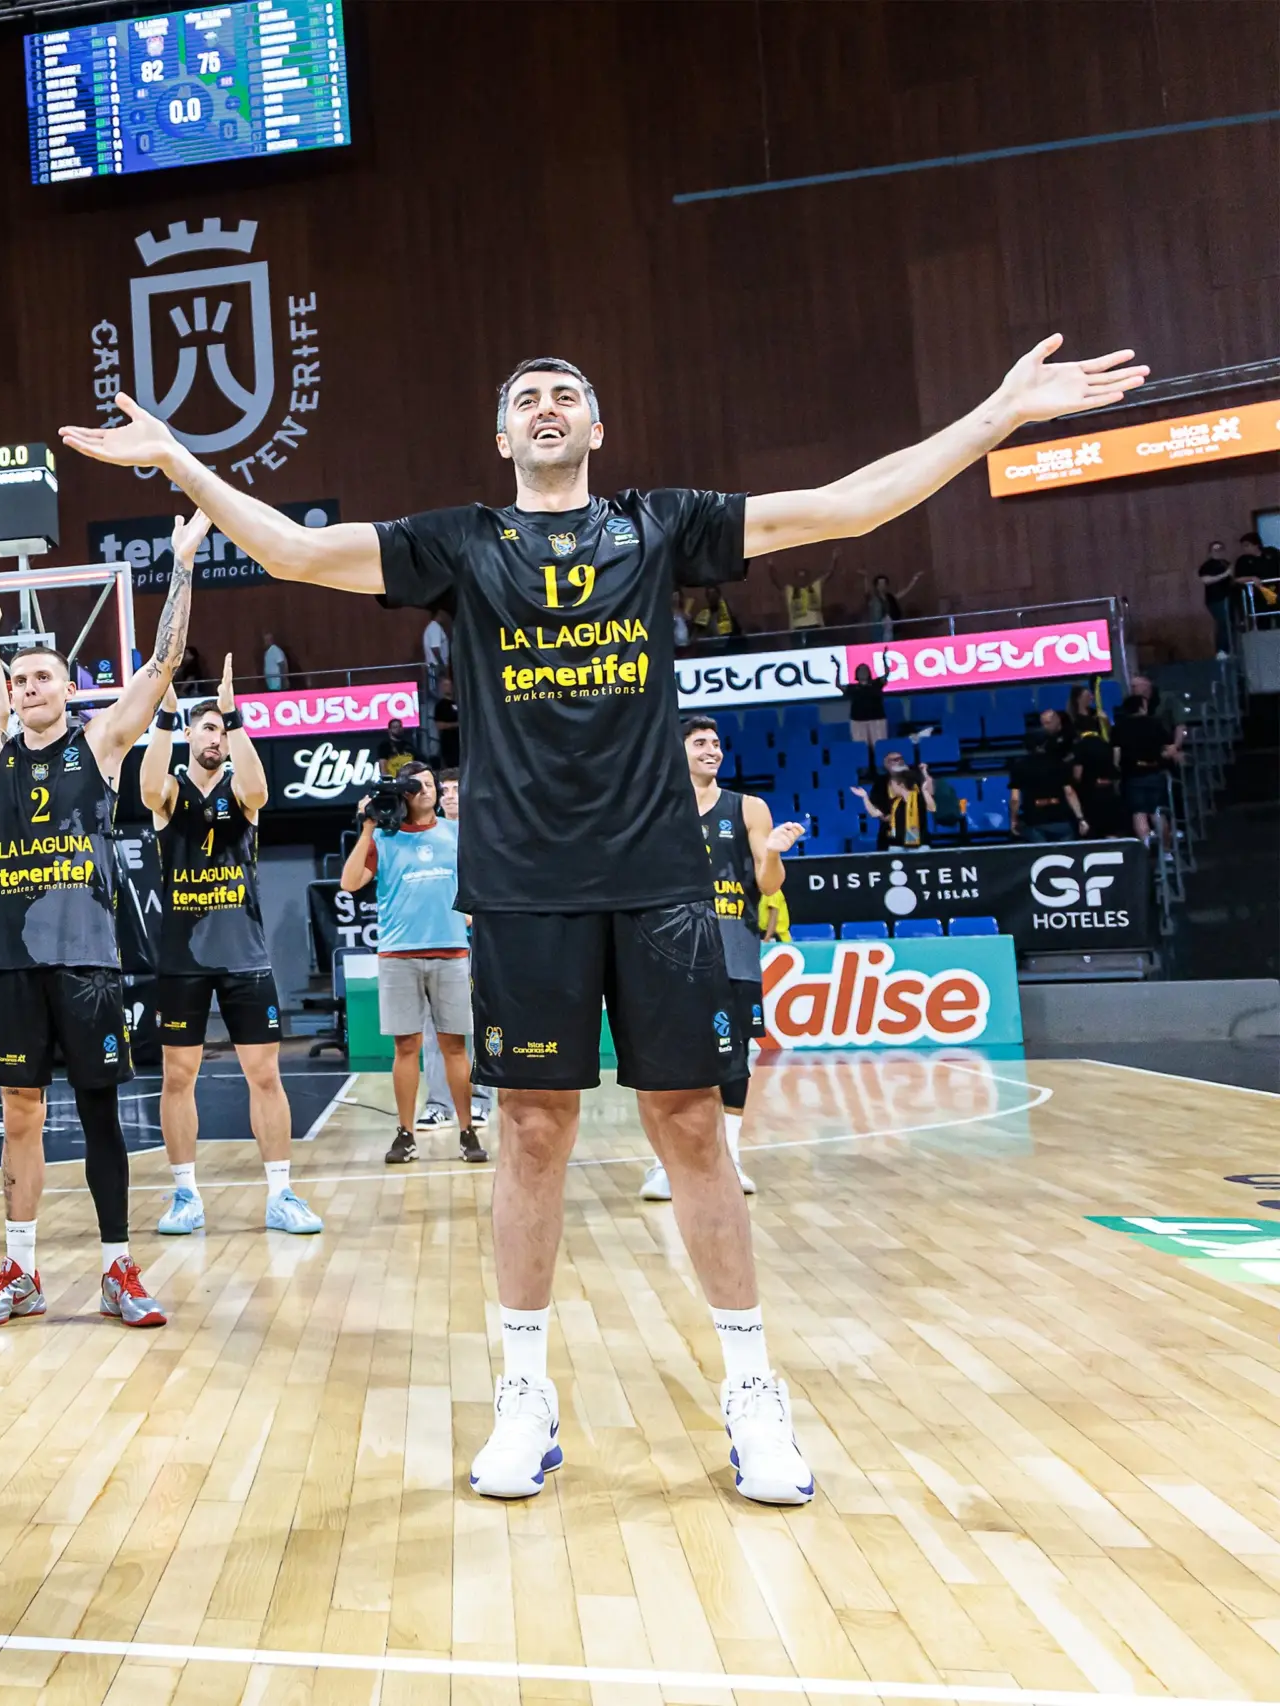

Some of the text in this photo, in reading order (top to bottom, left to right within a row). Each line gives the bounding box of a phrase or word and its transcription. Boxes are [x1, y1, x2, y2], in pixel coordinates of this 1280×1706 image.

[141, 59, 164, 83] 82
[169, 97, 201, 125] 0.0
[231, 292, 320, 485] TENERIFE
[202, 562, 265, 580] emocio
[539, 564, 596, 608] 19
[500, 618, 648, 651] LA LAGUNA
[914, 630, 1111, 678] austral
[501, 652, 650, 693] tenerife!
[676, 659, 832, 696] ustral
[505, 685, 636, 703] awakens emotions
[30, 787, 51, 824] 2
[21, 835, 94, 856] LAGUNA
[200, 828, 215, 857] 4
[173, 865, 244, 883] LA LAGUNA
[1030, 851, 1124, 907] GF
[38, 882, 85, 891] emotions
[173, 884, 245, 908] tenerife!
[714, 880, 745, 895] UNA
[937, 889, 980, 900] ISLAS
[1033, 910, 1130, 930] HOTELES
[504, 1322, 542, 1332] stral
